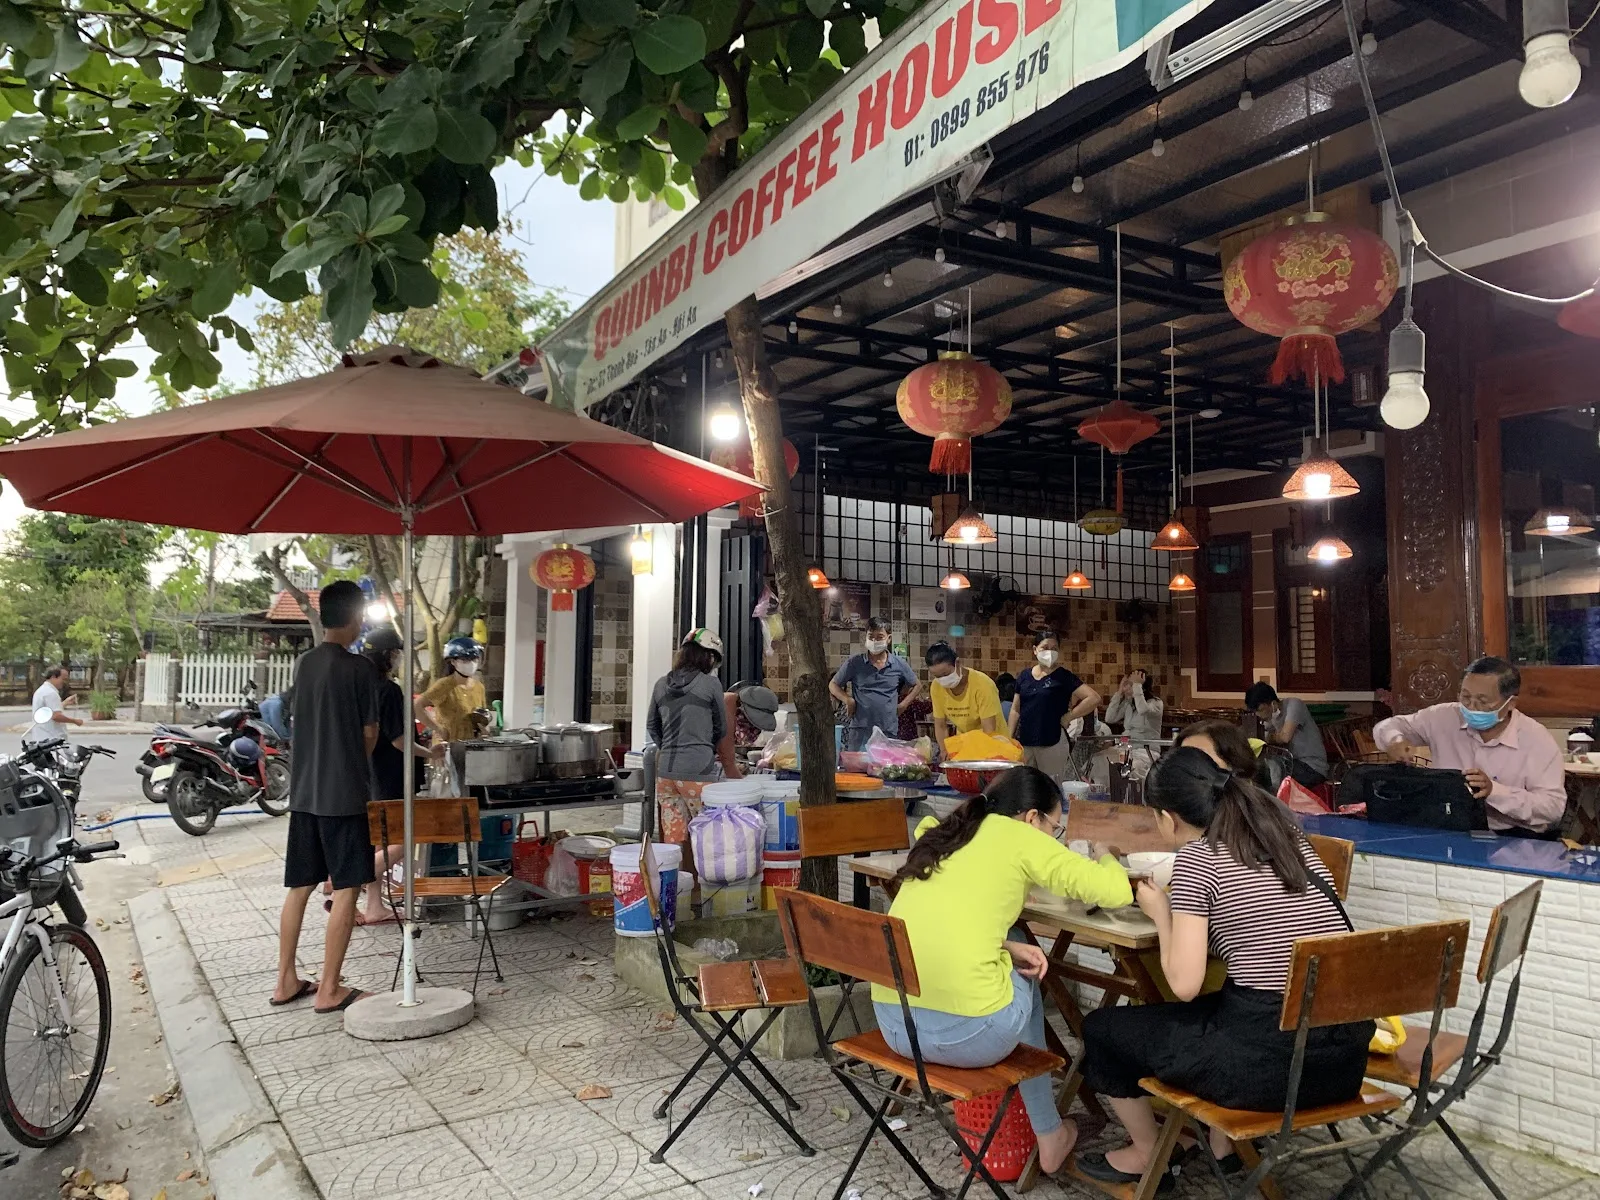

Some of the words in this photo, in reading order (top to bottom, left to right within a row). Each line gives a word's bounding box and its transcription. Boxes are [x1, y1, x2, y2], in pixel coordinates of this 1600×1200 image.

[930, 97, 971, 149] 0899
[976, 70, 1010, 117] 855
[1015, 40, 1050, 91] 976
[702, 108, 845, 275] COFFEE
